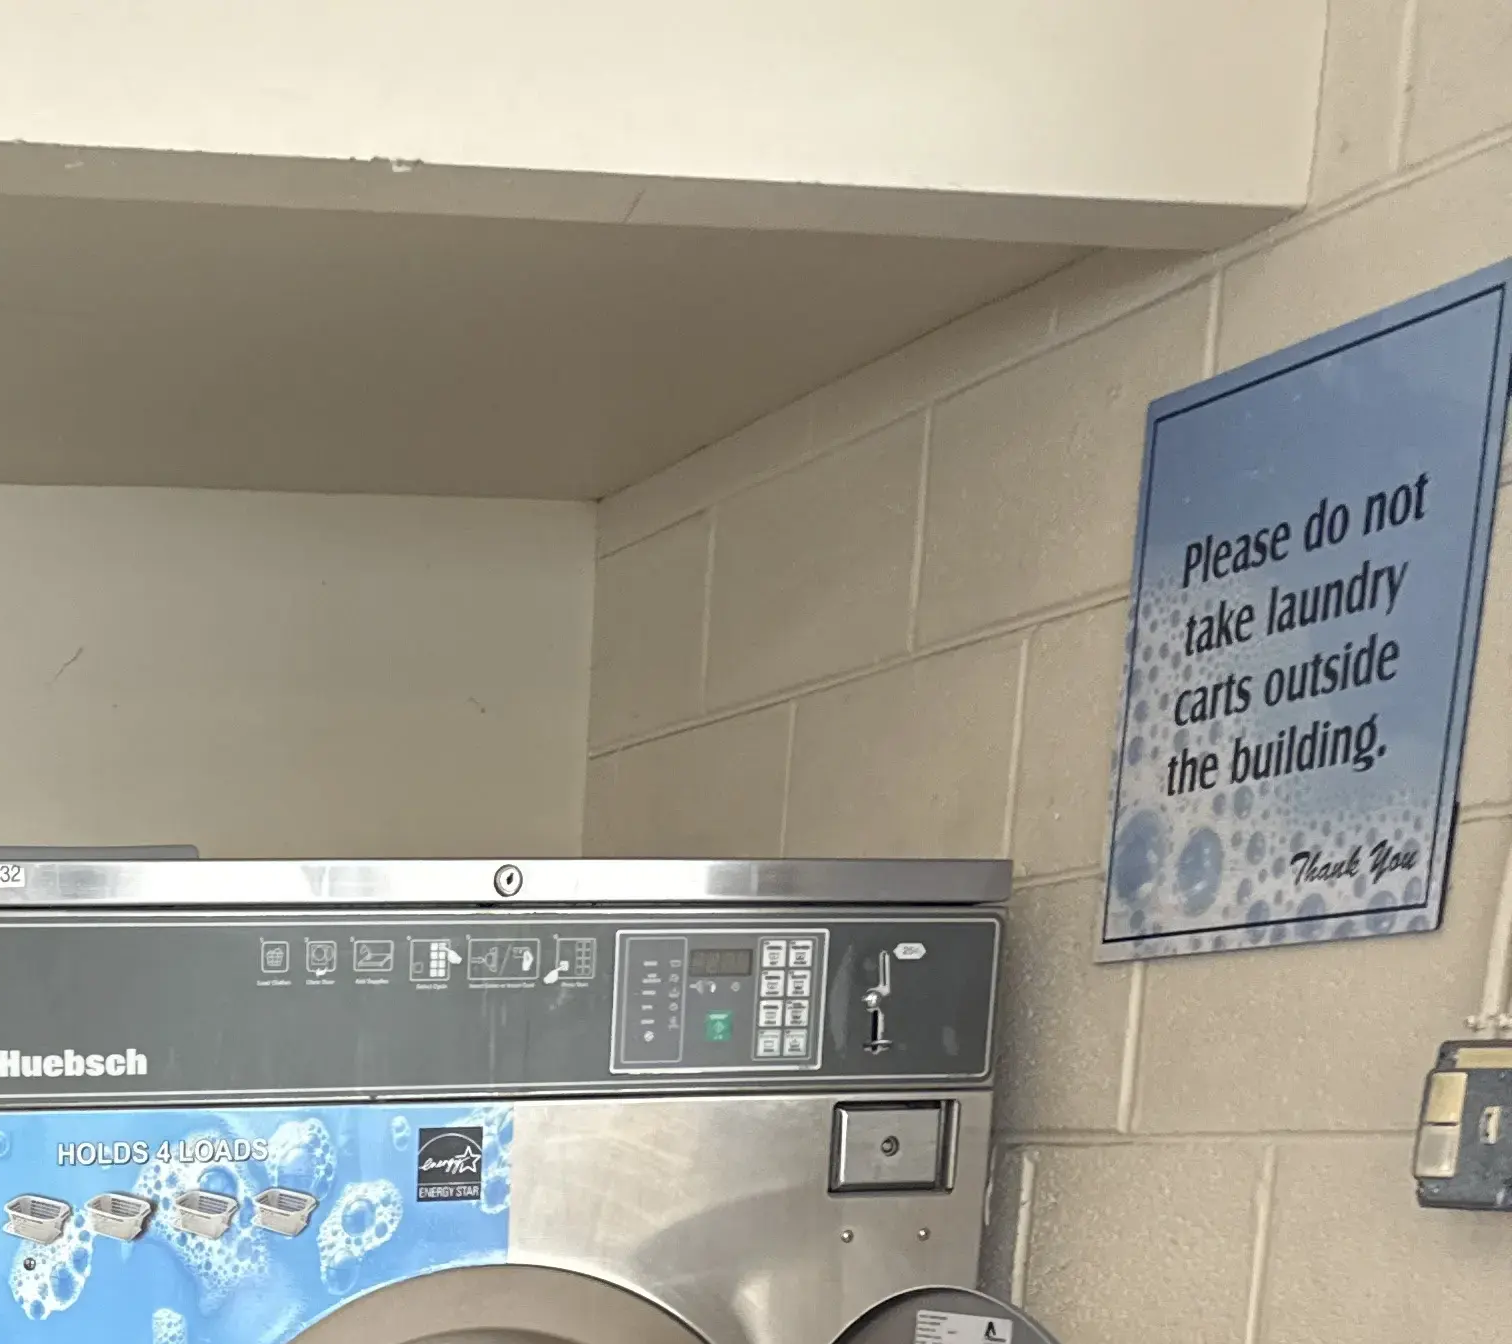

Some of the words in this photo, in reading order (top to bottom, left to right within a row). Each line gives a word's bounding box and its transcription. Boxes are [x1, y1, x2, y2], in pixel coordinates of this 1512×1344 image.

[1182, 522, 1290, 588] Please
[1304, 498, 1348, 552] do
[1363, 471, 1429, 536] not
[1186, 601, 1254, 657] take
[1266, 559, 1409, 636] laundry
[1174, 672, 1252, 727] carts
[1263, 632, 1400, 707] outside
[1167, 748, 1219, 797] the
[1229, 712, 1387, 785] building.
[0, 864, 21, 882] 32
[1290, 849, 1361, 886] Thank
[1370, 839, 1418, 885] You
[57, 1141, 150, 1166] HOLDS
[156, 1140, 172, 1164] 4
[179, 1138, 270, 1162] LOADS
[418, 1185, 455, 1198] ENERGY
[455, 1185, 479, 1197] STAR
